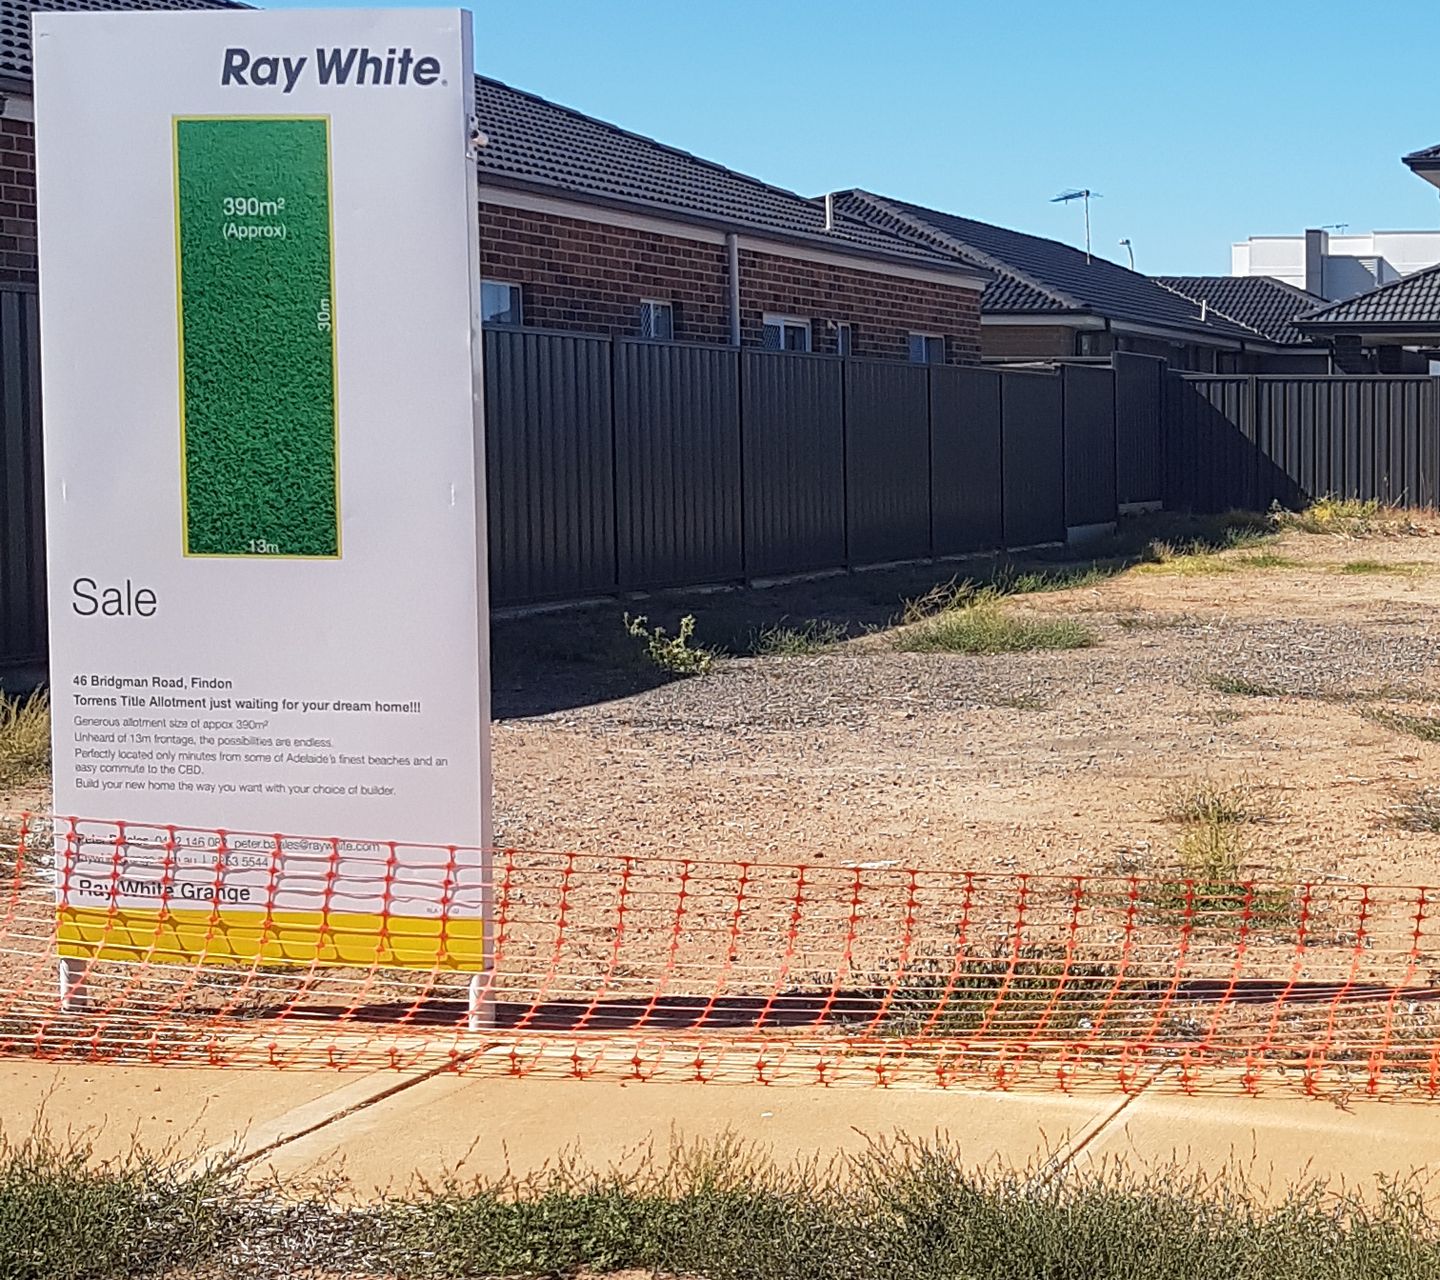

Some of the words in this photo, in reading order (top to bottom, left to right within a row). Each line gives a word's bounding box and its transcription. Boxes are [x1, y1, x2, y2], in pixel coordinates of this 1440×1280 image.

[221, 48, 308, 94] Ray
[316, 48, 441, 86] White
[222, 223, 287, 240] (Approx)
[317, 298, 331, 332] 30m
[250, 539, 279, 554] 13m
[72, 577, 157, 617] Sale
[73, 676, 87, 687] 46
[91, 676, 148, 690] Bridgman
[152, 677, 188, 690] Road,
[191, 677, 233, 689] Findon
[73, 695, 117, 706] Torrens
[120, 695, 146, 707] Title
[149, 696, 206, 708] Allotment
[209, 698, 232, 710] just
[235, 698, 278, 712] waiting
[282, 699, 299, 710] for
[302, 701, 330, 713] your
[333, 700, 371, 712] dream
[375, 701, 421, 713] home!!!
[74, 716, 120, 727] Generous
[123, 717, 166, 728] allotment
[169, 718, 188, 728] size
[190, 718, 200, 728] of
[74, 732, 114, 743] Unheard
[117, 733, 127, 743] of
[130, 734, 151, 744] 13m
[154, 734, 196, 747] frontage,
[199, 735, 215, 745] the
[217, 736, 273, 747] possibilities
[276, 738, 291, 747] are
[75, 748, 115, 761] Perfectly
[118, 749, 153, 760] located
[156, 751, 176, 762] only
[178, 751, 217, 762] minutes
[219, 751, 241, 761] from
[244, 753, 271, 762] some
[274, 753, 284, 762] of
[286, 753, 336, 764] Adelaide's
[339, 754, 365, 765] finest
[368, 755, 411, 766] beaches
[413, 756, 432, 766] and
[435, 758, 448, 766] an
[75, 765, 96, 775] easy
[100, 765, 145, 774] commute
[148, 765, 157, 774] to
[160, 764, 175, 775] the
[178, 765, 204, 775] CBD.
[76, 778, 99, 789] Build
[102, 781, 122, 791] your
[125, 781, 145, 789] new
[148, 780, 175, 790] home
[178, 780, 194, 791] the
[196, 783, 215, 793] way
[218, 784, 236, 794] you
[239, 783, 263, 792] want
[266, 783, 286, 793] with
[288, 785, 309, 795] your
[313, 784, 345, 795] choice
[348, 785, 358, 795] of
[242, 857, 268, 867] 5544
[181, 883, 250, 902] Grange
